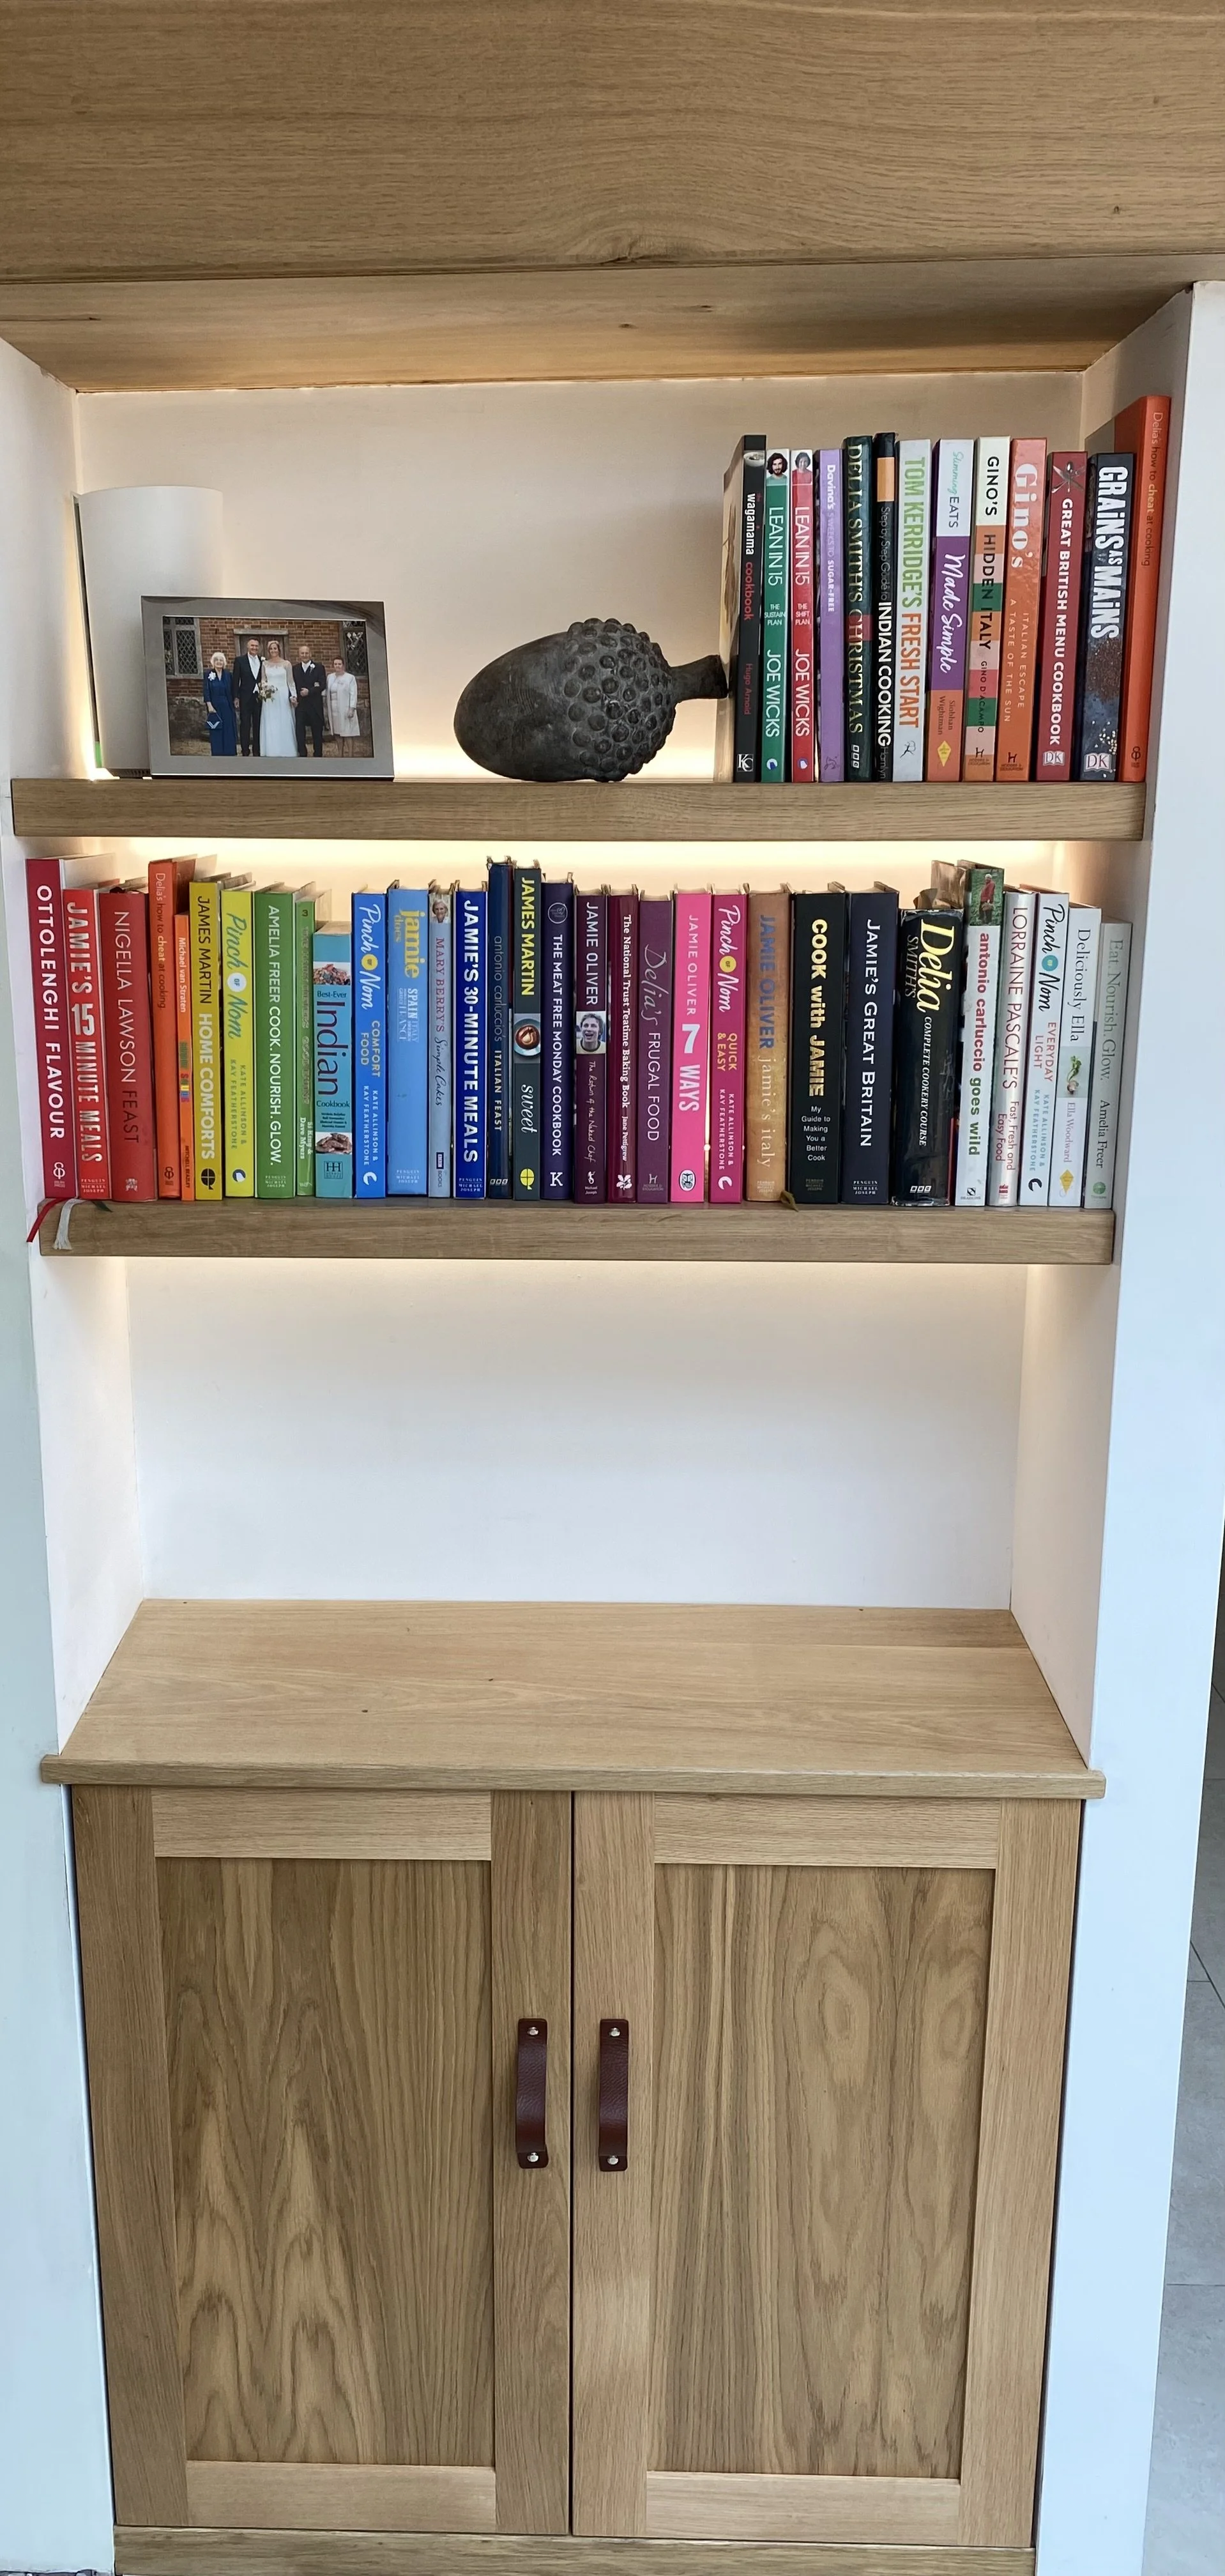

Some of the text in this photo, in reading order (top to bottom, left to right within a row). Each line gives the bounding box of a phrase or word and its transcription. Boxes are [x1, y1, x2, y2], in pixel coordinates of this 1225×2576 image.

[827, 465, 836, 509] Davina's
[949, 496, 960, 528] EATS
[1011, 464, 1037, 568] Gino's
[1141, 412, 1163, 566] Delia's how to cheat at cooking
[744, 493, 756, 620] wagamama cookbook
[768, 507, 784, 585] LEAN IN 15
[848, 444, 864, 733] DELIA SMITH'S CHRISTMAS
[899, 457, 925, 728] TOM KERRIDGE'S FRESH START
[978, 456, 1000, 648] GINO'S HIDDEN ITALY
[1108, 550, 1123, 564] AS
[939, 553, 966, 673] Made Simple
[1007, 653, 1014, 667] OF
[1008, 611, 1016, 647] TASTE
[1049, 498, 1074, 745] GREAT BRITISH MENU COOKBOOK
[765, 650, 781, 737] JOE WICKS
[878, 602, 892, 746] INDIAN COOKING
[1017, 613, 1029, 709] ITALIAN ESCAPE
[937, 696, 946, 735] Wightman
[948, 700, 956, 730] Siobhan
[1004, 698, 1012, 722] SUN
[114, 912, 136, 1082] NIGELLA LAWSON
[179, 938, 187, 969] Michael
[179, 985, 188, 1013] Straten
[904, 935, 918, 997] SMITH'S
[917, 919, 954, 1013] Delia
[1003, 907, 1028, 1089] LORRAINE PASCALE'S
[1039, 904, 1065, 1011] Pinch Nom
[1068, 928, 1091, 1041] Deliciously Ella
[36, 885, 65, 1138] OTTOLENGHI FLAVOUR
[67, 902, 103, 1162] JAMIE'S 15 MINUTE MEALS
[197, 896, 215, 1159] JAMES MARTIN HOME COMFORTS
[269, 905, 282, 1165] AMELIA FREER COOK. NOURISH. GLOW.
[317, 1000, 348, 1095] Indian
[463, 900, 479, 1162] JAMIE'S 30-MINUTE MEALS
[552, 934, 563, 1156] THE MEAT FREE MONDAY COOKBOOK
[620, 915, 631, 1108] The National Trust Teatime Baking Book
[678, 915, 701, 1111] JAMIE OLIVER 7 WAYS
[727, 1033, 737, 1070] QUICK
[809, 919, 827, 1096] COOK with JAMIE
[860, 919, 880, 1146] JAMIE'S GREAT BRITAIN
[969, 933, 991, 1155] antonio carluccio goes wild
[1033, 1036, 1044, 1068] LIGHT
[1044, 1022, 1056, 1082] EVERYDAY
[1103, 972, 1120, 1037] Nourish.
[647, 1032, 661, 1141] FRUGAL FOOD
[717, 1043, 726, 1071] EASY
[918, 1016, 931, 1146] COMPLETE COOKERY COURSE
[1100, 1039, 1116, 1080] Glow.
[620, 1132, 628, 1161] Pettigrew
[995, 1114, 1008, 1161] Easy Food
[1007, 1125, 1017, 1150] Fresh
[1063, 1119, 1075, 1163] Woodward
[1066, 1102, 1076, 1117] Ella
[1095, 1100, 1110, 1168] Amelia Freer
[1007, 1152, 1016, 1170] and
